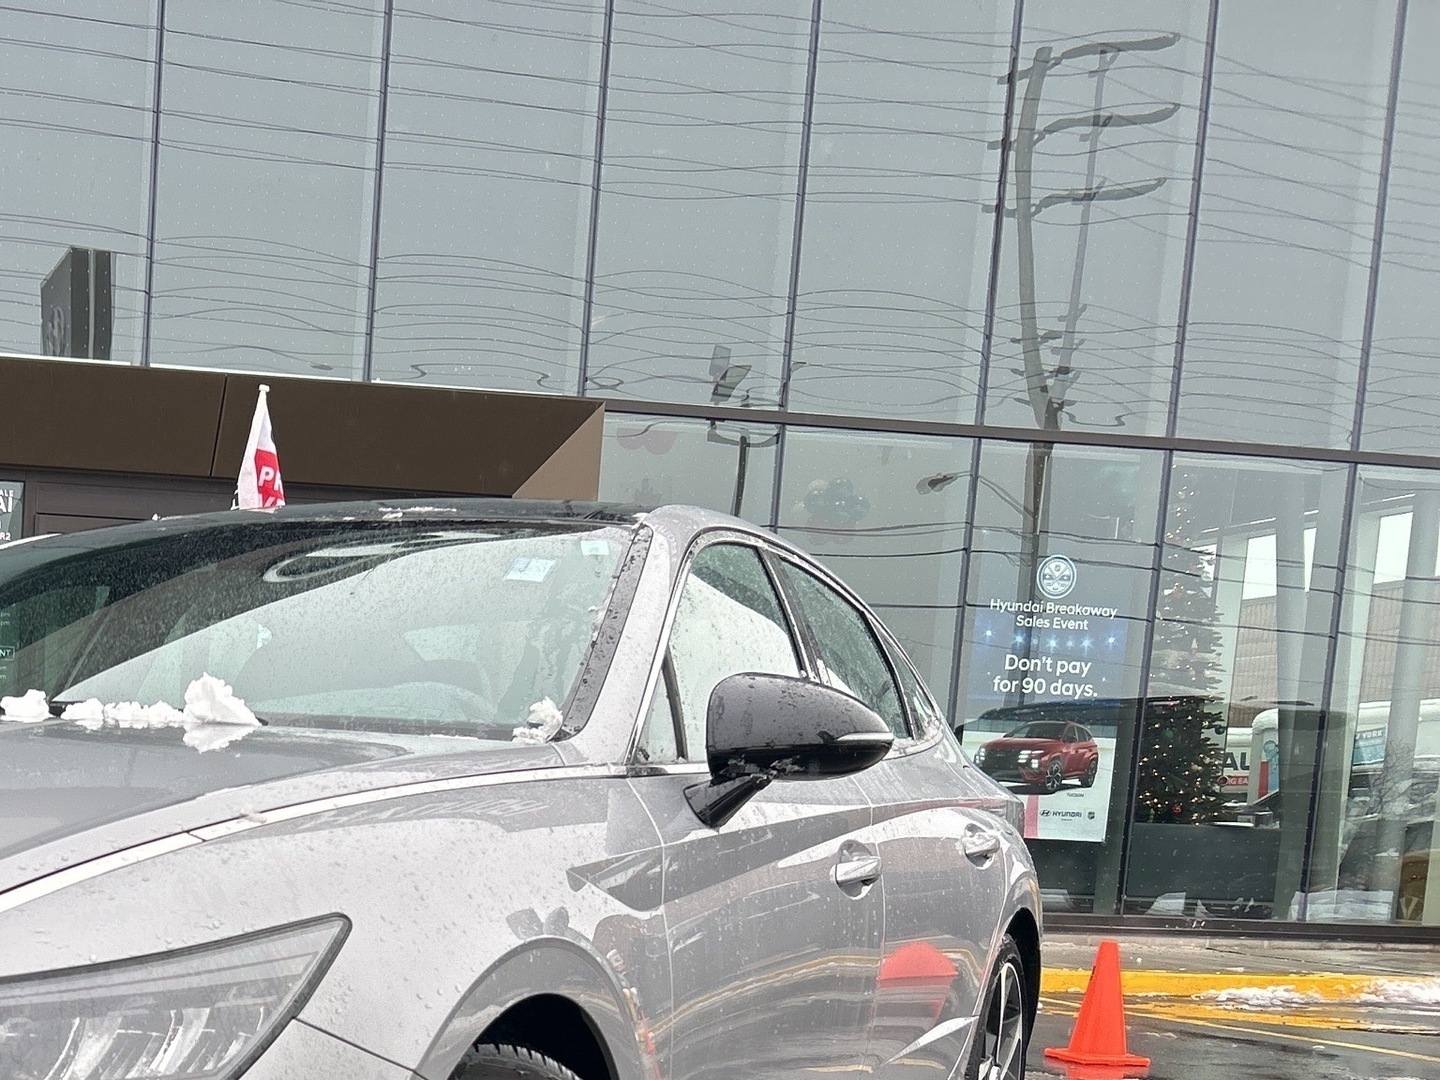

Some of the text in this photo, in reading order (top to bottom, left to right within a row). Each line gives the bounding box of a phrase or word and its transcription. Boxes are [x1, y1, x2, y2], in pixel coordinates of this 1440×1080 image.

[989, 598, 1118, 619] Hyundai Breakaway
[1016, 614, 1089, 631] Sales Event
[1004, 653, 1092, 678] Don't pay
[992, 675, 1098, 700] for 90 days.
